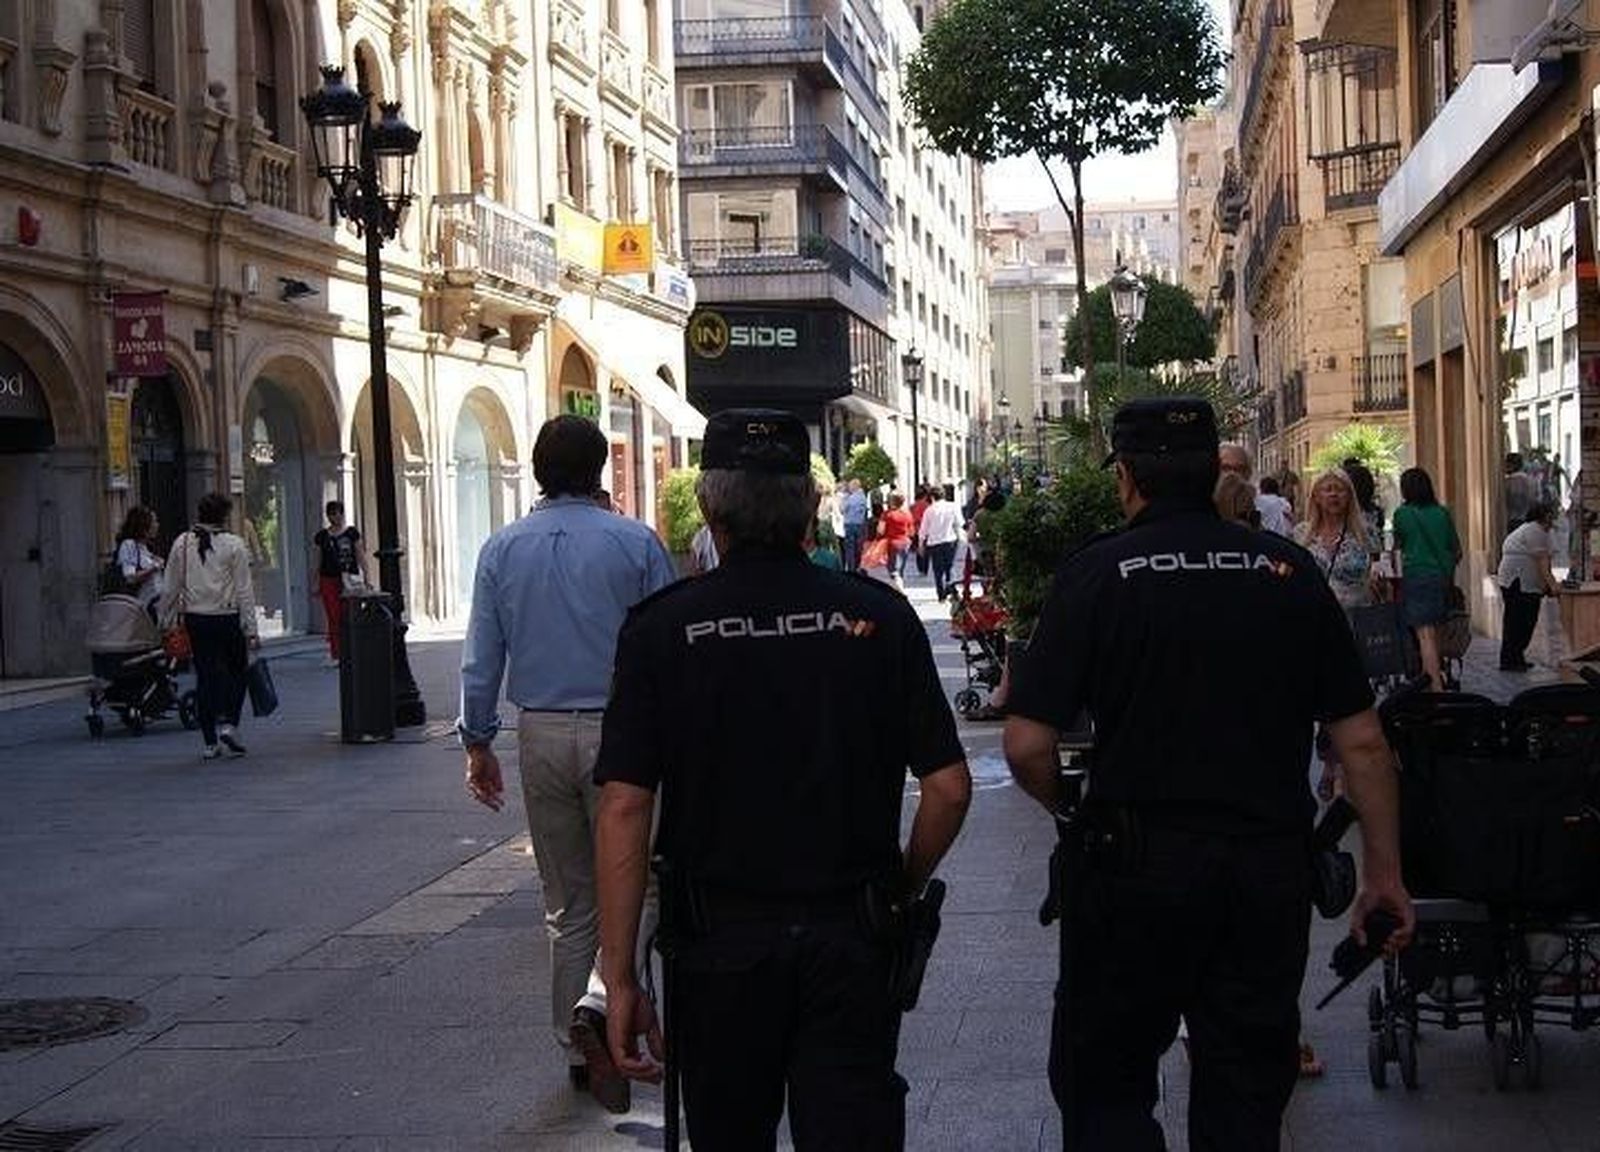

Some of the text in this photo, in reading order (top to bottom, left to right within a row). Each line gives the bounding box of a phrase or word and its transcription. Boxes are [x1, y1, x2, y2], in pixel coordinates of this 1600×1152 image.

[697, 326, 721, 345] IN
[1117, 551, 1276, 580] POLICIA
[684, 610, 852, 645] POLICIA
